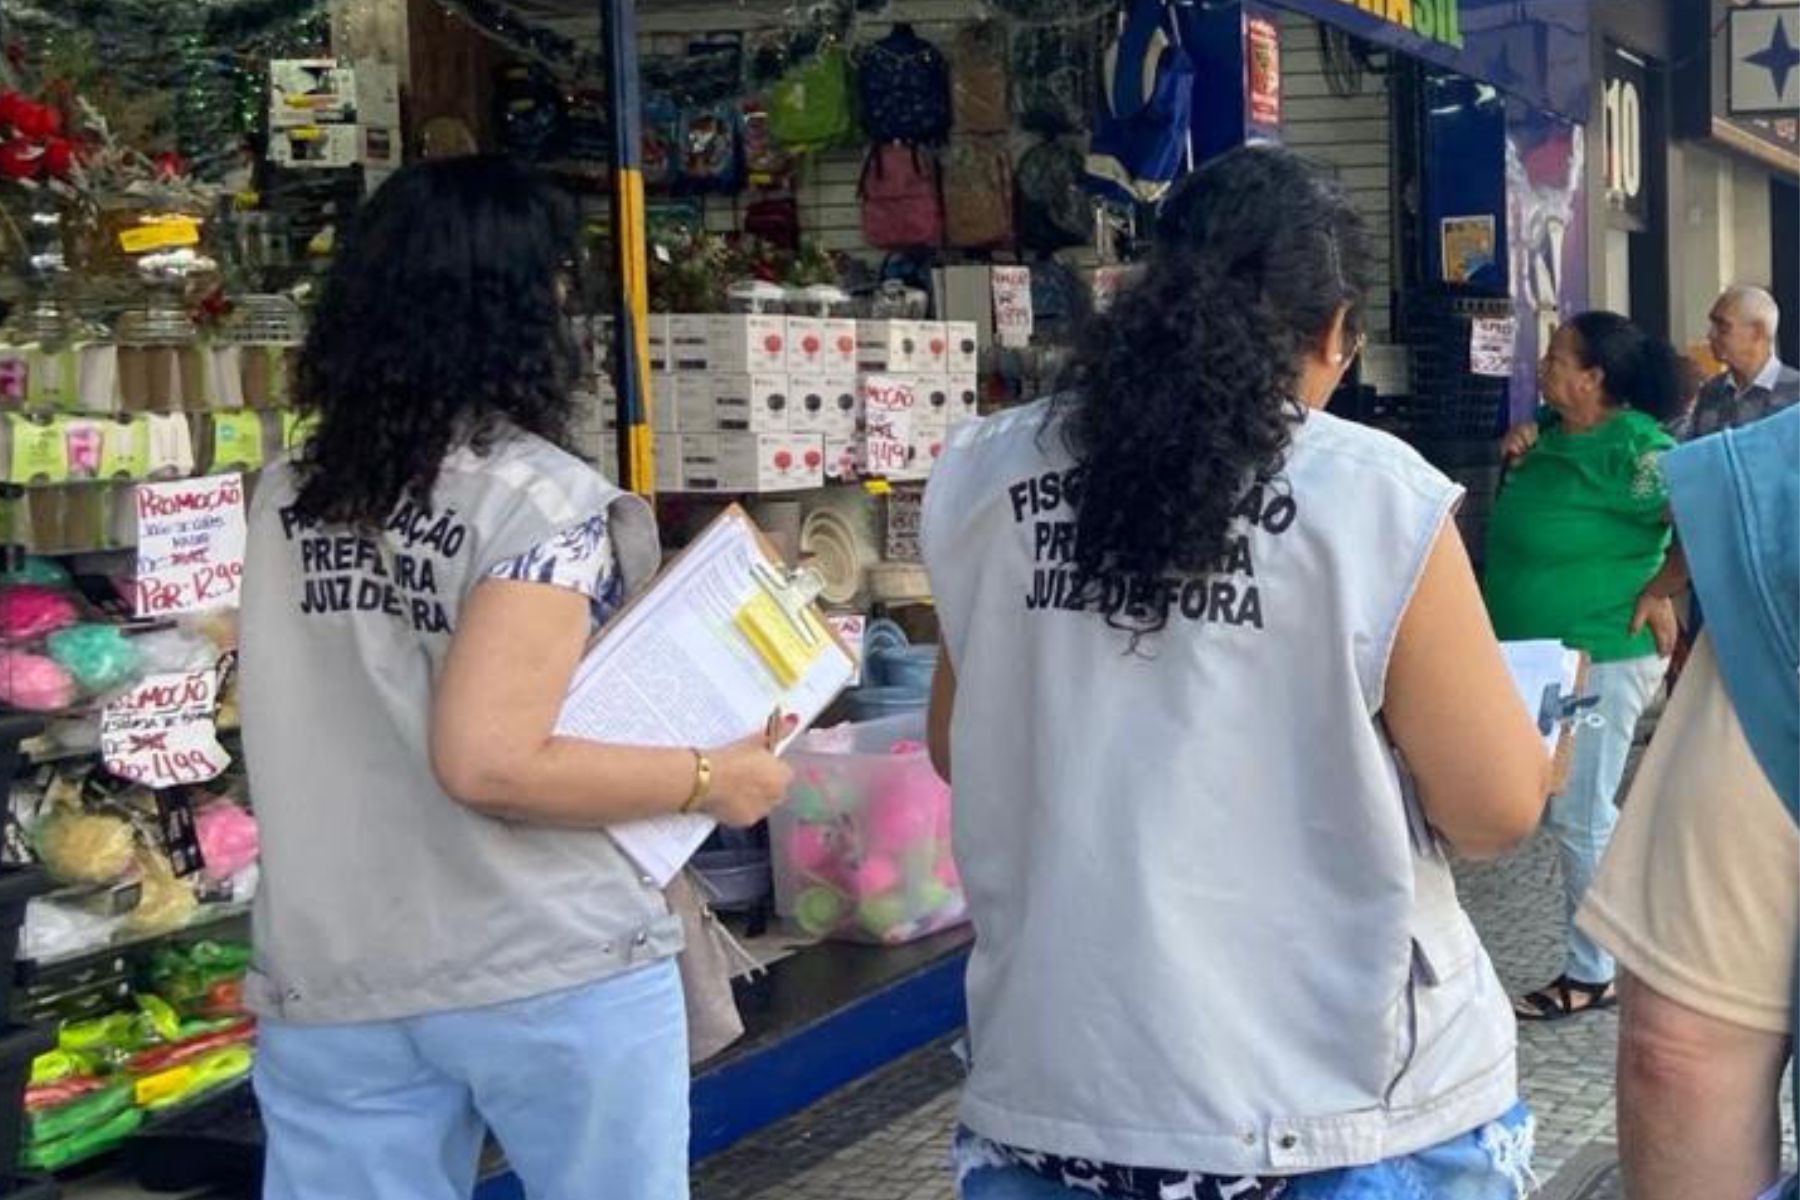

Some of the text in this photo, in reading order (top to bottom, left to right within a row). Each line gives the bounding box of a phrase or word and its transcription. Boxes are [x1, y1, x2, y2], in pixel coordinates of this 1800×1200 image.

[137, 479, 240, 519] PROMOÇÃO
[301, 575, 352, 614] JUIZ
[356, 577, 403, 617] DE
